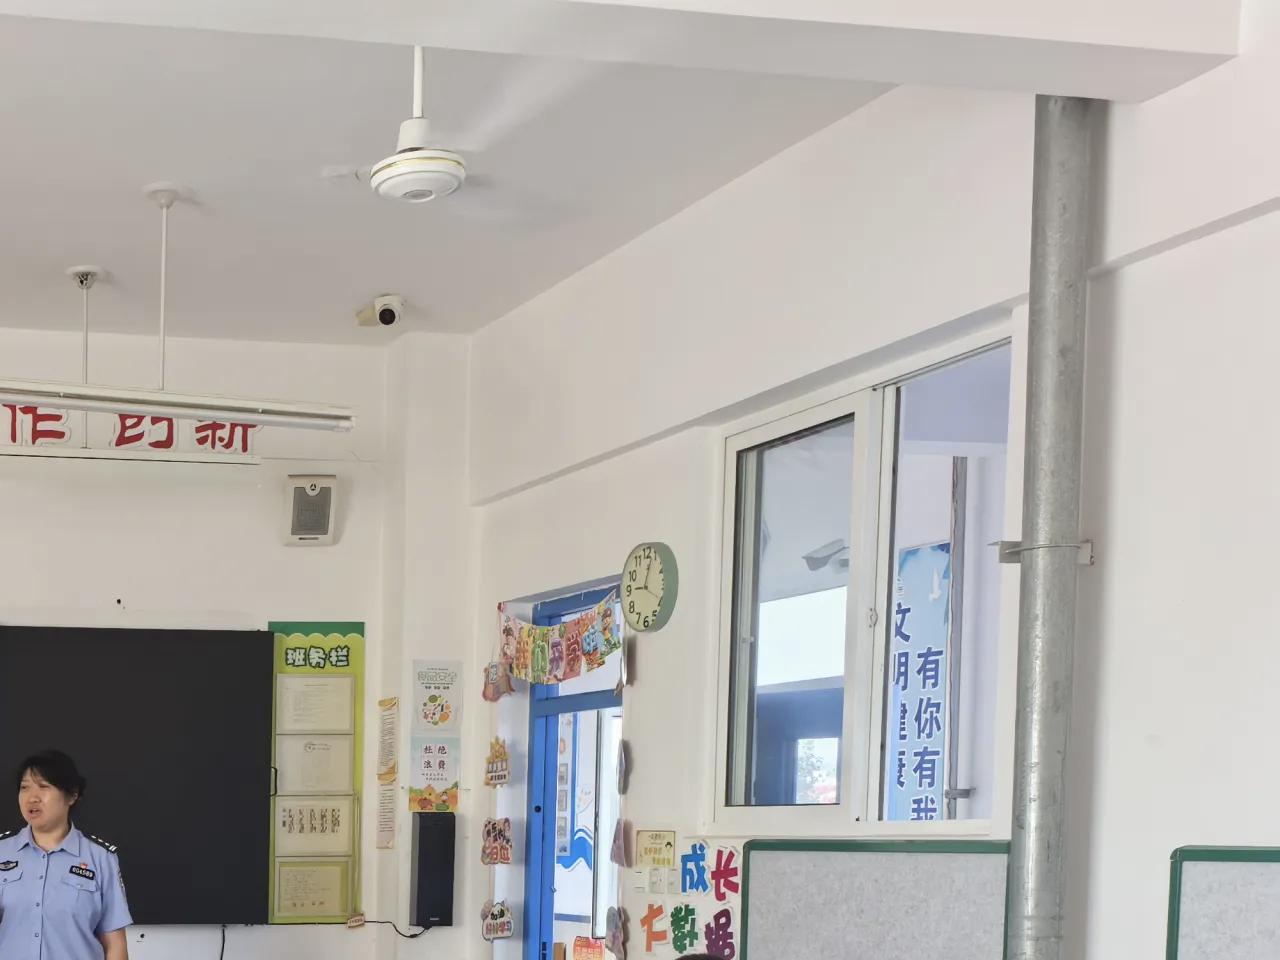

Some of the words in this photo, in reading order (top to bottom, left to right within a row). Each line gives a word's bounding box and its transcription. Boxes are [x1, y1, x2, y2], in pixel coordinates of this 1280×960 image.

[643, 546, 652, 560] 12
[634, 555, 642, 567] 11
[629, 570, 637, 582] 10
[626, 585, 632, 597] 9
[628, 601, 635, 614] 8
[636, 612, 641, 625] 7
[643, 616, 649, 628] 6
[680, 842, 740, 902] 成长
